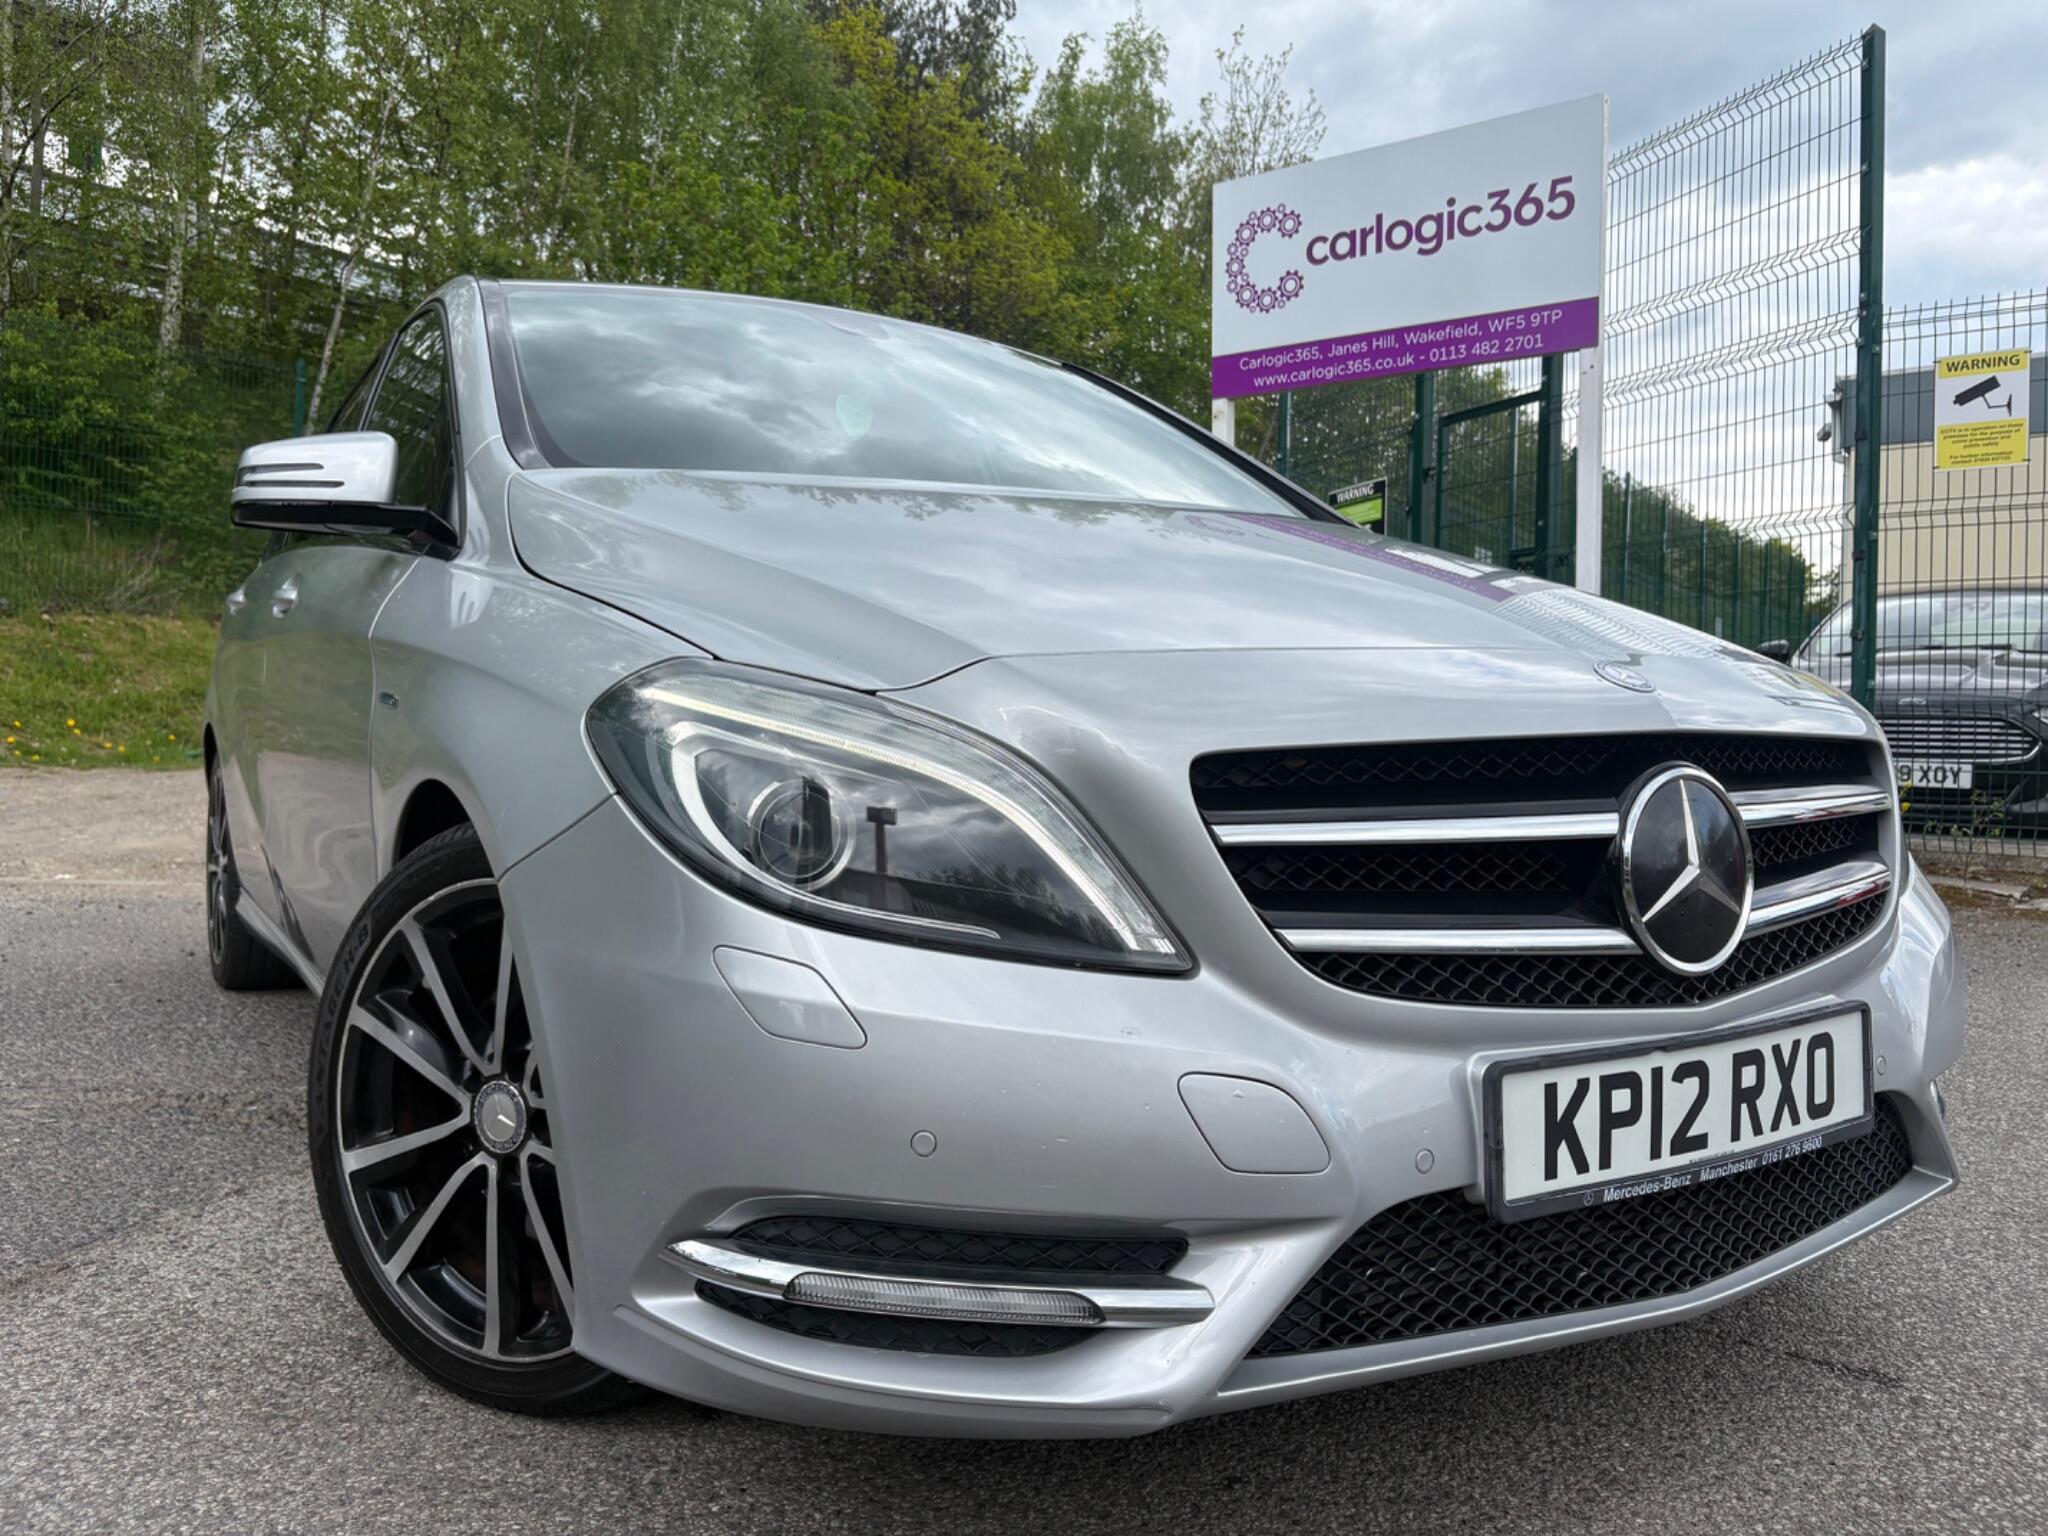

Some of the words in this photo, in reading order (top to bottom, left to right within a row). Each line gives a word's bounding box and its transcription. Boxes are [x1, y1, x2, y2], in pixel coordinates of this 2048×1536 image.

[1306, 175, 1575, 266] carlogic365
[1239, 347, 1323, 371] Carlogic365,
[1328, 341, 1368, 358] Janes
[1372, 334, 1399, 351] Hill,
[1404, 322, 1482, 345] Wakefield,
[1488, 315, 1526, 333] WF5
[1530, 309, 1563, 327] 9TP
[1253, 352, 1415, 388] www.carlogic365.co.uk
[1429, 345, 1467, 362] 0113
[1471, 340, 1500, 356] 482
[1505, 334, 1544, 352] 2701
[1946, 353, 2020, 373] WARNING
[1336, 483, 1374, 504] WARNING
[1919, 765, 1962, 785] XOY
[1544, 1060, 1710, 1182] KP12
[1731, 1031, 1835, 1143] RXO
[1603, 1174, 1692, 1202] Mercedes-Benz
[1700, 1158, 1758, 1181] Manchester
[1762, 1149, 1782, 1166] 0161
[1784, 1142, 1801, 1158] 276
